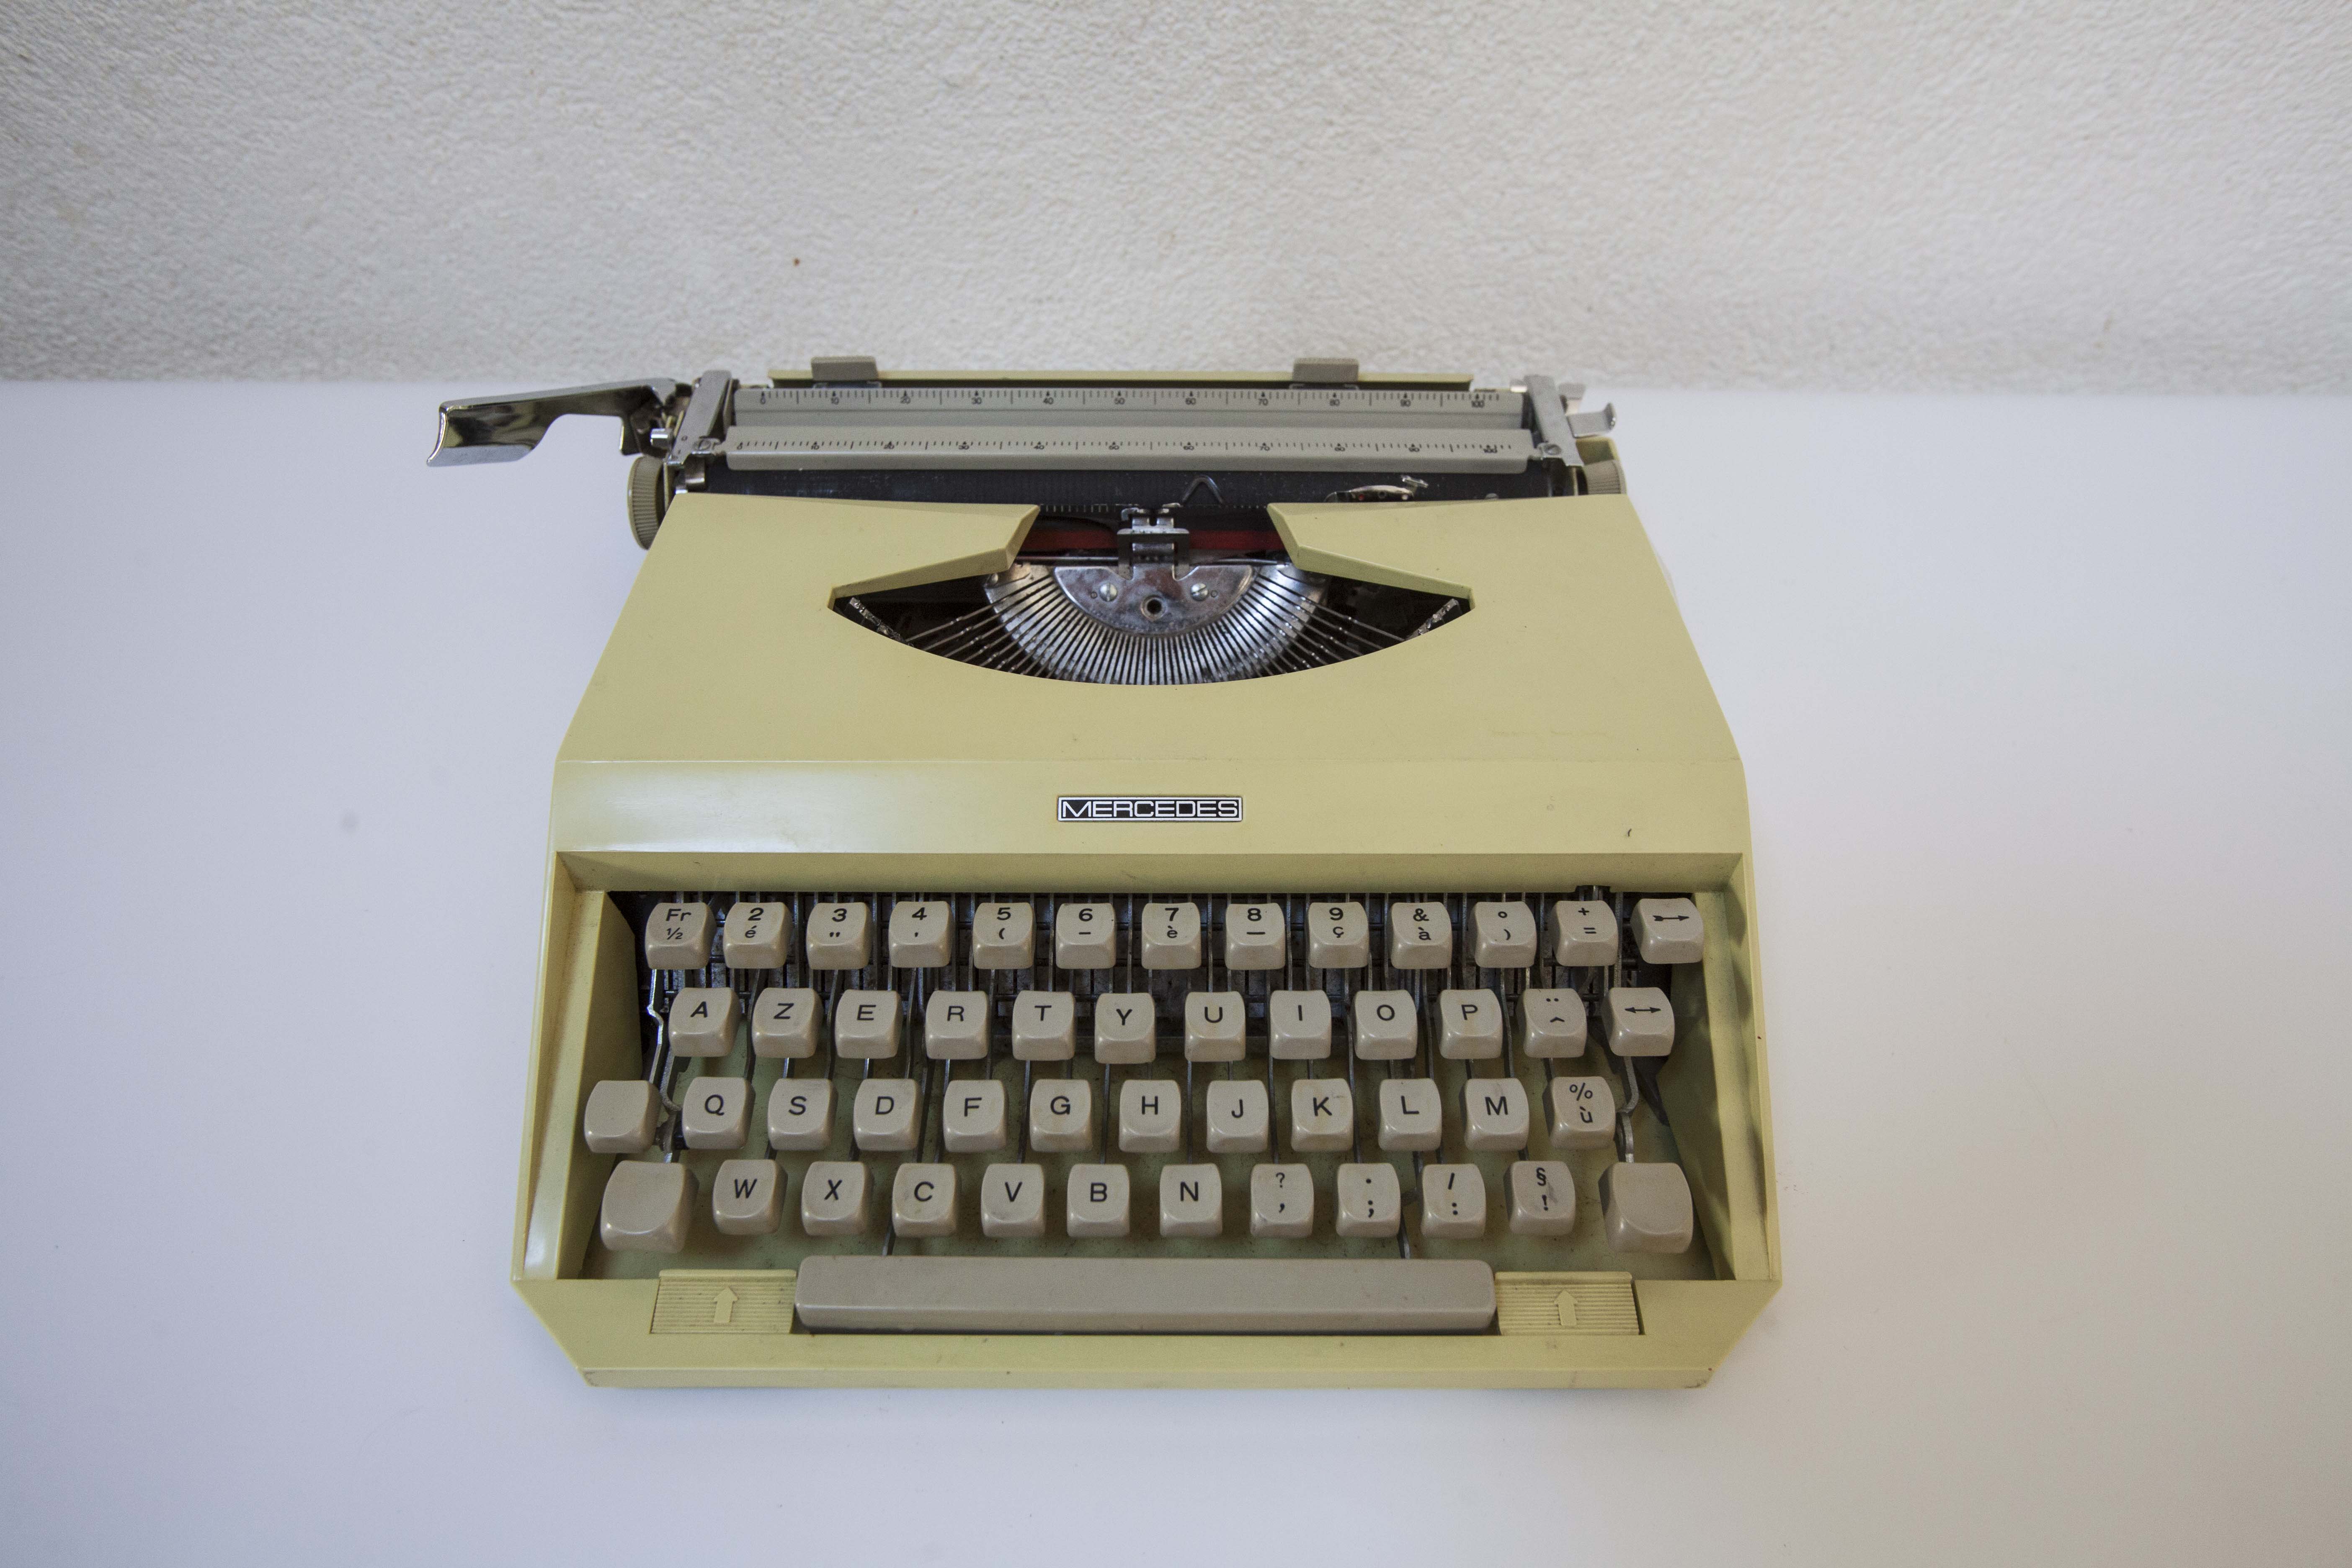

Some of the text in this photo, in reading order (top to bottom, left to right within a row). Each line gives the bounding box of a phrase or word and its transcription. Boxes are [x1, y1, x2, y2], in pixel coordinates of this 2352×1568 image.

[1063, 800, 1238, 817] MERCEDES
[666, 908, 691, 921] Fr
[748, 907, 764, 921] 2
[832, 908, 847, 922] 3
[912, 907, 927, 920] 4
[997, 907, 1011, 921] 5
[1078, 908, 1093, 922] 6
[1165, 907, 1179, 921] 7
[1247, 908, 1262, 922] 8
[1329, 907, 1344, 921] 9
[1413, 908, 1429, 922] &
[745, 925, 757, 939] é
[998, 928, 1005, 939] (
[1167, 925, 1178, 939] è
[1333, 926, 1344, 938] ç
[1418, 927, 1431, 941] à
[1504, 929, 1511, 940] )
[690, 1001, 708, 1018] A
[774, 1003, 794, 1019] Z
[857, 1004, 876, 1021] E
[947, 1006, 965, 1021] R
[1034, 1005, 1052, 1021] T
[1116, 1008, 1132, 1026] Y
[1204, 1006, 1223, 1024] U
[1298, 1005, 1303, 1021] I
[1377, 1004, 1395, 1021] O
[1461, 1004, 1478, 1020] P
[1569, 1082, 1593, 1101] %
[704, 1094, 724, 1116] Q
[789, 1096, 807, 1116] S
[875, 1096, 894, 1115] D
[964, 1097, 982, 1117] F
[1050, 1096, 1070, 1115] G
[1141, 1096, 1158, 1115] H
[1231, 1099, 1243, 1119] J
[1313, 1097, 1332, 1117] K
[1400, 1096, 1419, 1115] L
[1485, 1096, 1508, 1115] M
[1579, 1106, 1593, 1123] ù
[1275, 1173, 1285, 1188] ?
[1448, 1173, 1455, 1190] /
[1536, 1167, 1547, 1186] §
[734, 1179, 757, 1199] W
[824, 1179, 842, 1200] X
[914, 1181, 934, 1202] C
[1005, 1182, 1022, 1202] V
[1090, 1182, 1107, 1202] B
[1180, 1181, 1199, 1202] N
[1279, 1203, 1285, 1212] ,
[1368, 1200, 1374, 1218] ;
[1452, 1202, 1458, 1215] :
[1542, 1194, 1548, 1211] !
